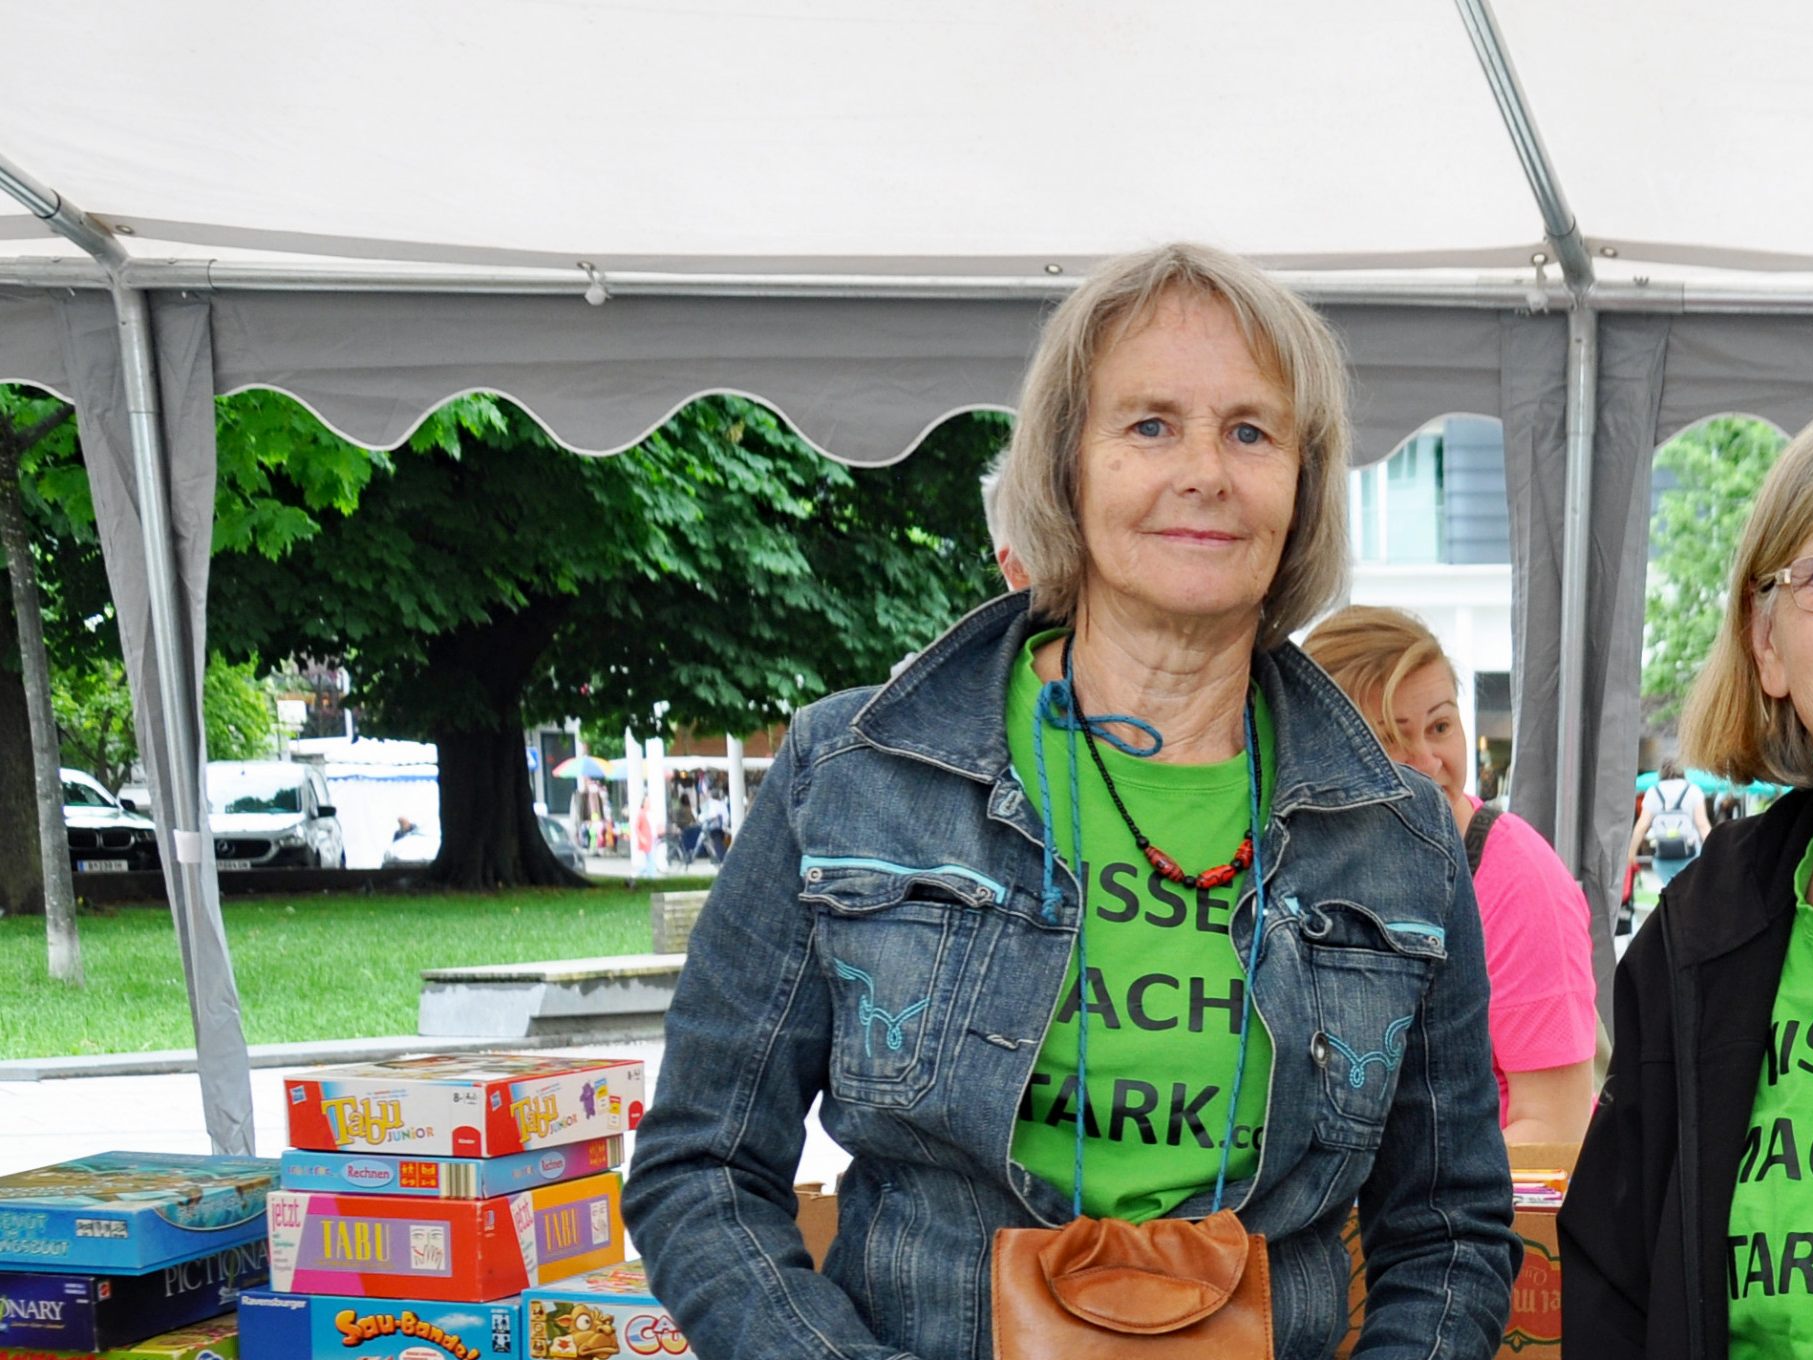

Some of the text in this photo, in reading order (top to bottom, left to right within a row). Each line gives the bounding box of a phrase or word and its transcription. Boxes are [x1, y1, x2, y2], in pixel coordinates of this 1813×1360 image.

[322, 1096, 404, 1145] Tabu
[511, 1093, 558, 1143] Tabu
[347, 1165, 389, 1180] Rechnen
[272, 1198, 300, 1232] jetzt
[512, 1198, 534, 1236] jetzt
[544, 1208, 579, 1251] TABU
[320, 1220, 391, 1262] TABU
